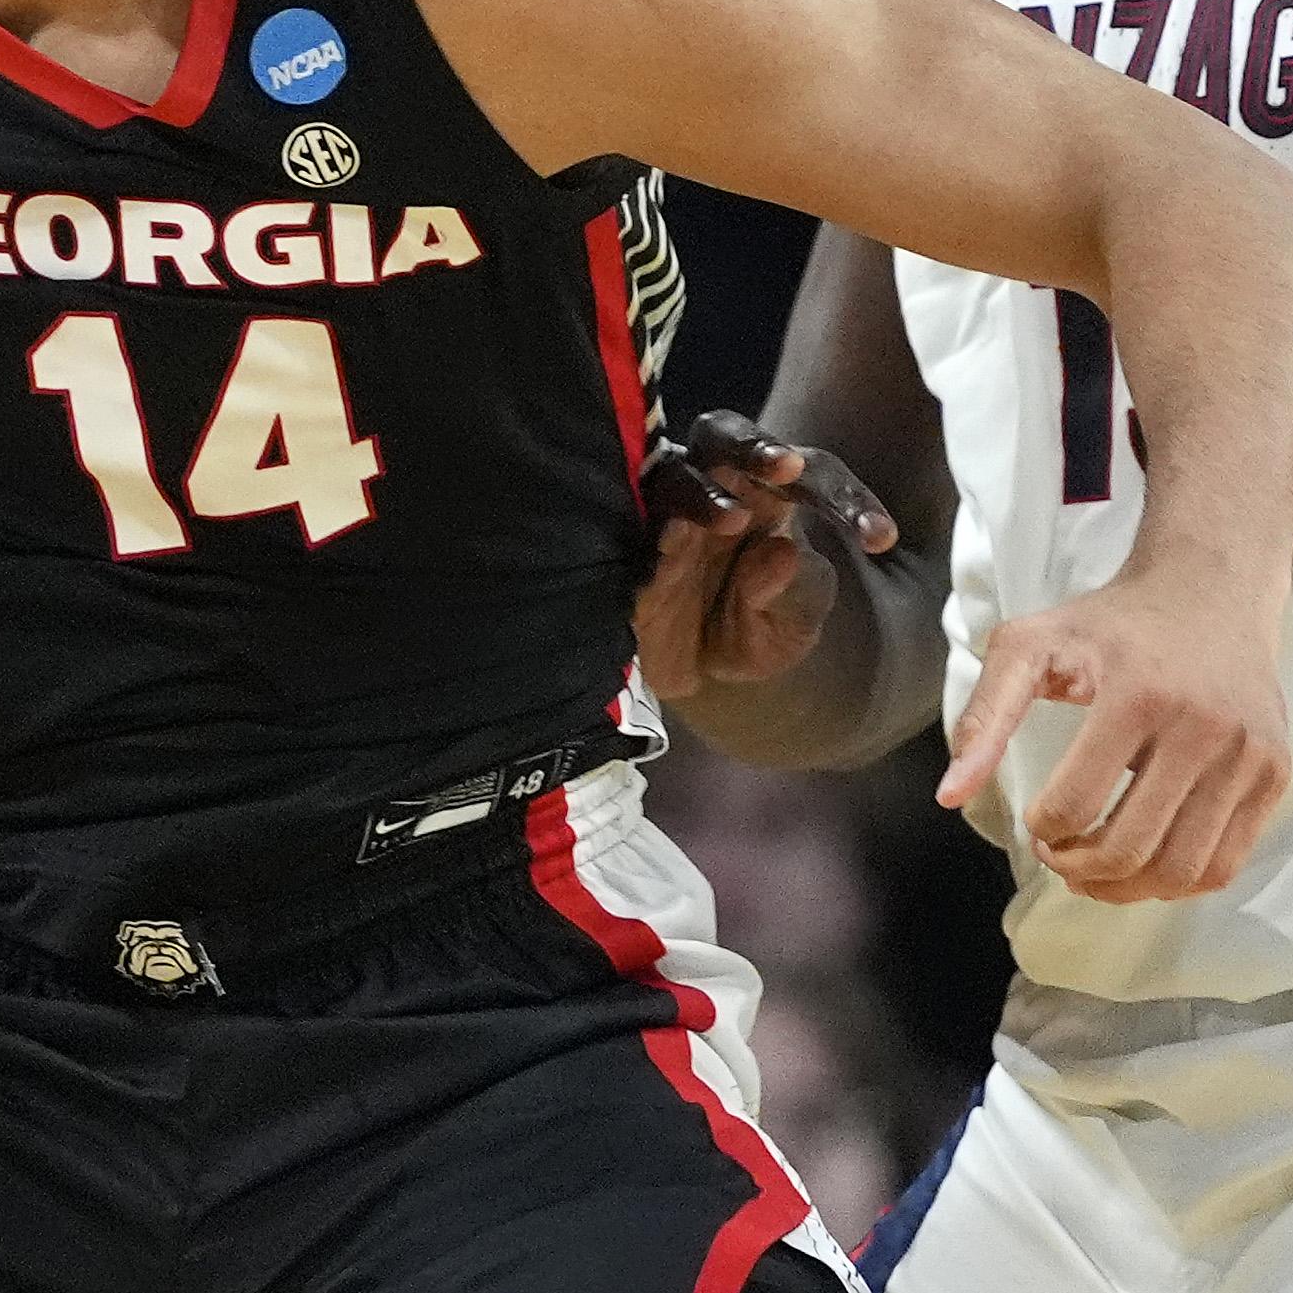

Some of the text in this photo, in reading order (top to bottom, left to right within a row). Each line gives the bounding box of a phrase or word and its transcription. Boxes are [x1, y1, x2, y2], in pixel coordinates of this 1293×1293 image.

[266, 39, 344, 91] NCAA
[289, 129, 354, 184] SEC
[26, 310, 385, 562] 14
[508, 769, 546, 800] 48
